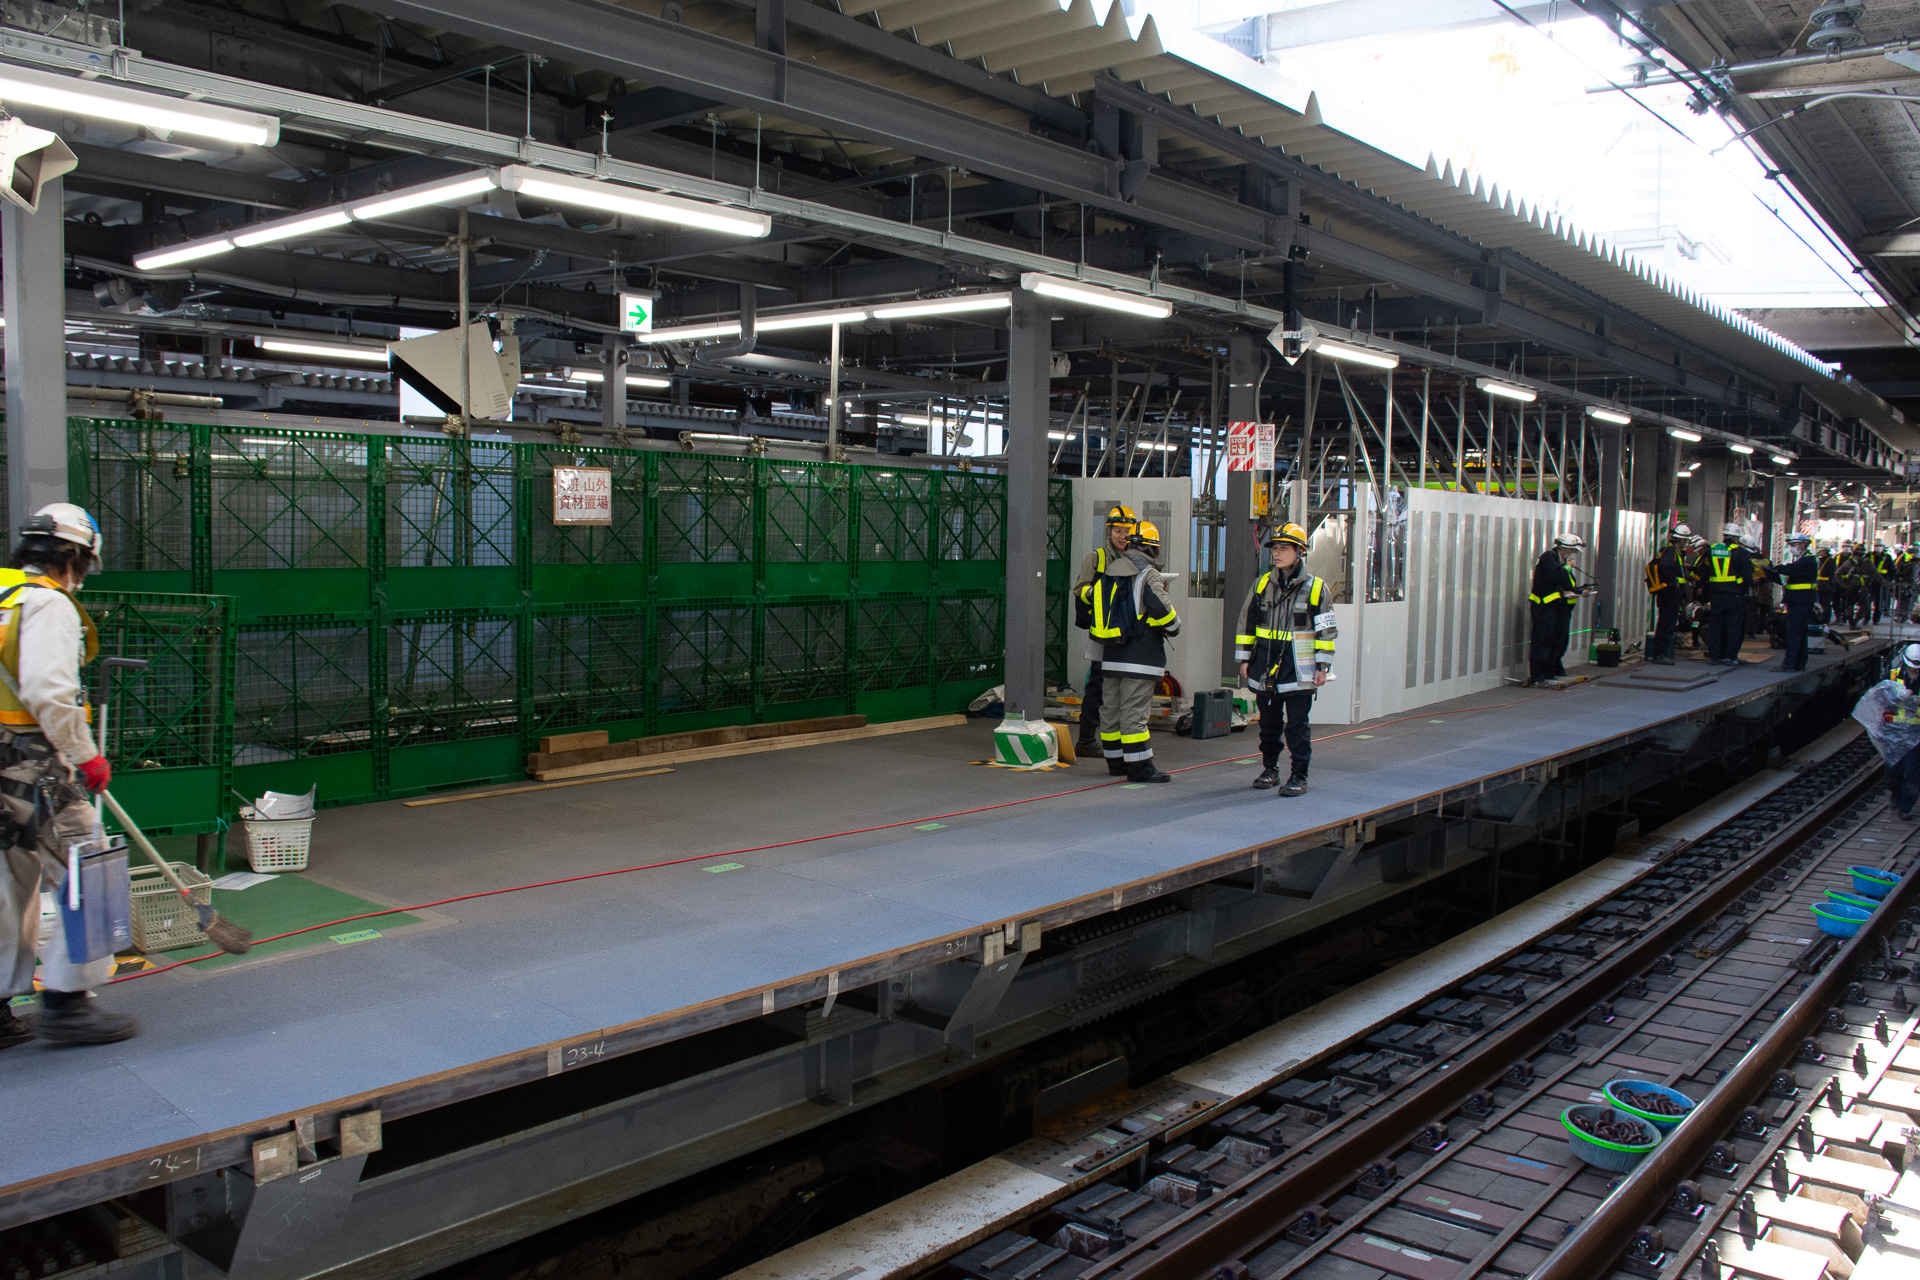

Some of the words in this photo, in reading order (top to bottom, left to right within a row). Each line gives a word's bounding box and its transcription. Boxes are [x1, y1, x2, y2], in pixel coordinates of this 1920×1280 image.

[584, 478, 607, 492] 山外
[560, 495, 608, 509] 資材置場
[567, 1041, 605, 1066] 23-4
[149, 1147, 201, 1179] 24-1
